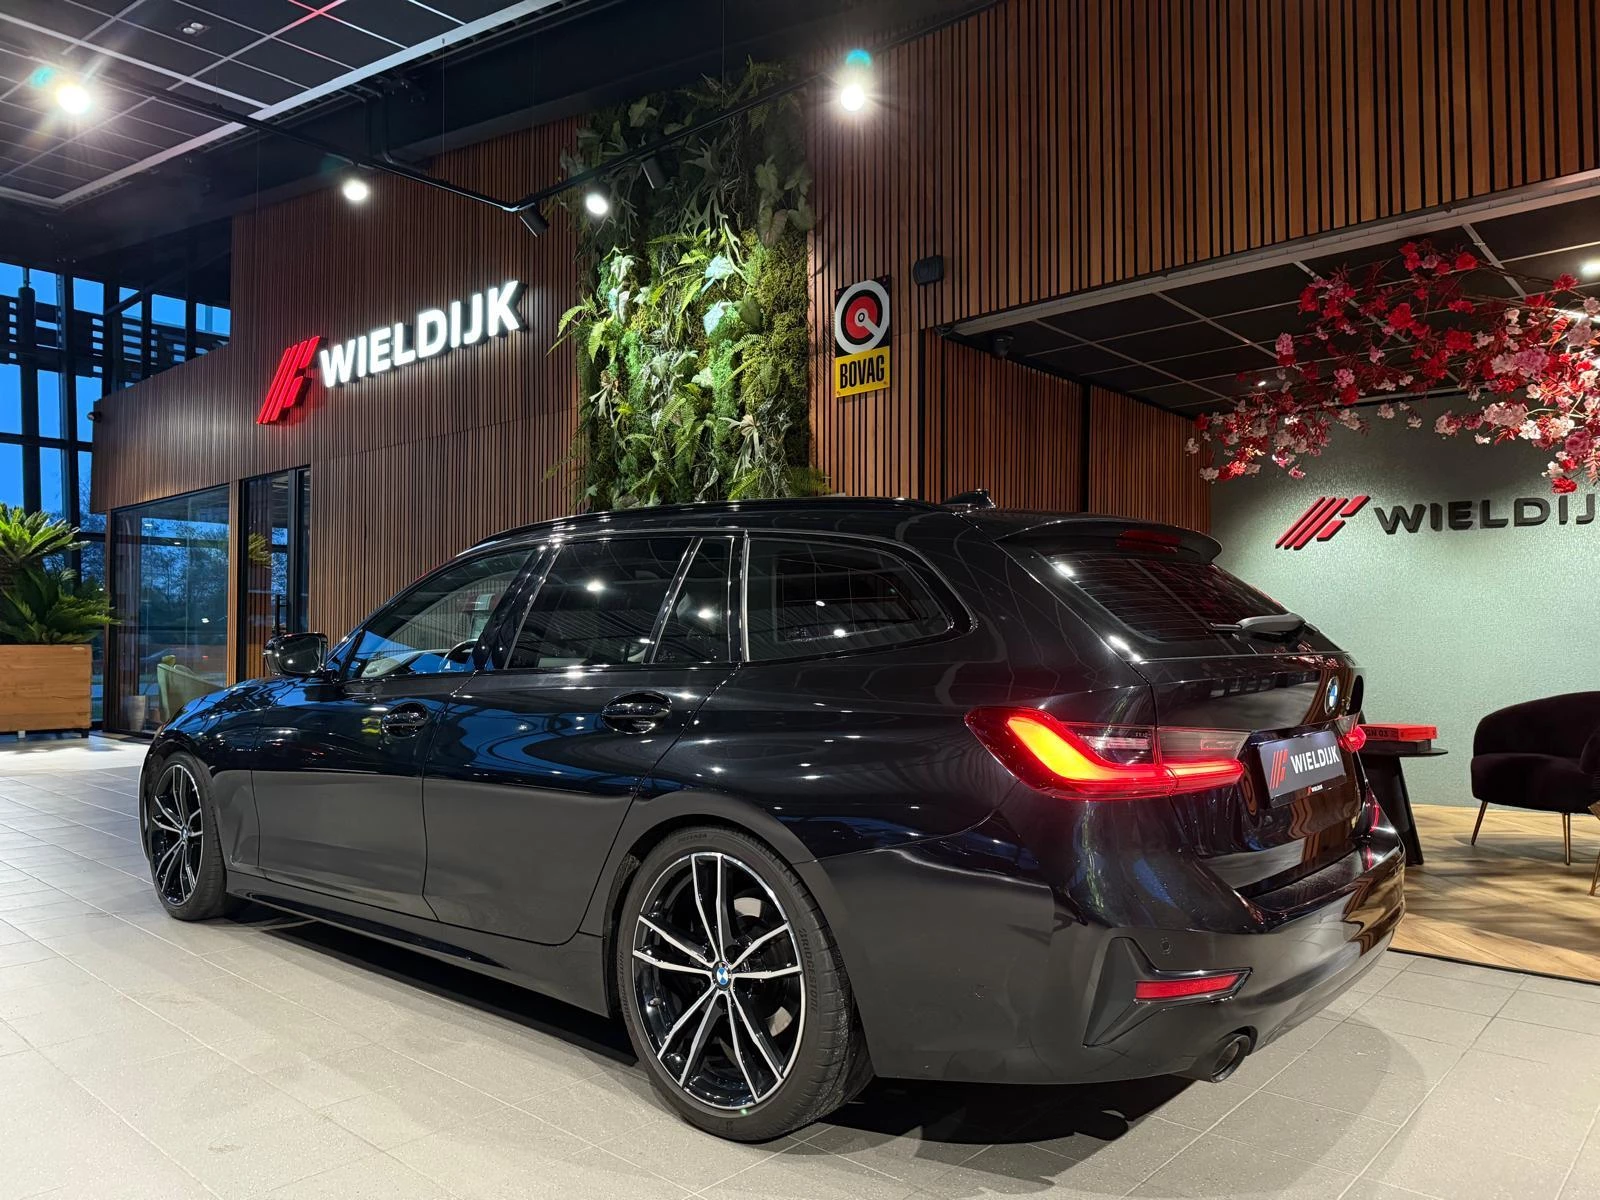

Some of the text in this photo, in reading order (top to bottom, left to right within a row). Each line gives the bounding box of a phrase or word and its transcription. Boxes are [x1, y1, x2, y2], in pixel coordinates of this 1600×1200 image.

[319, 279, 526, 388] WIELDIJK
[839, 354, 885, 389] BOVAG
[1373, 493, 1596, 535] WIELDIJ
[1290, 745, 1340, 773] WIELDIJK
[798, 928, 818, 1014] BRIDGESTONE
